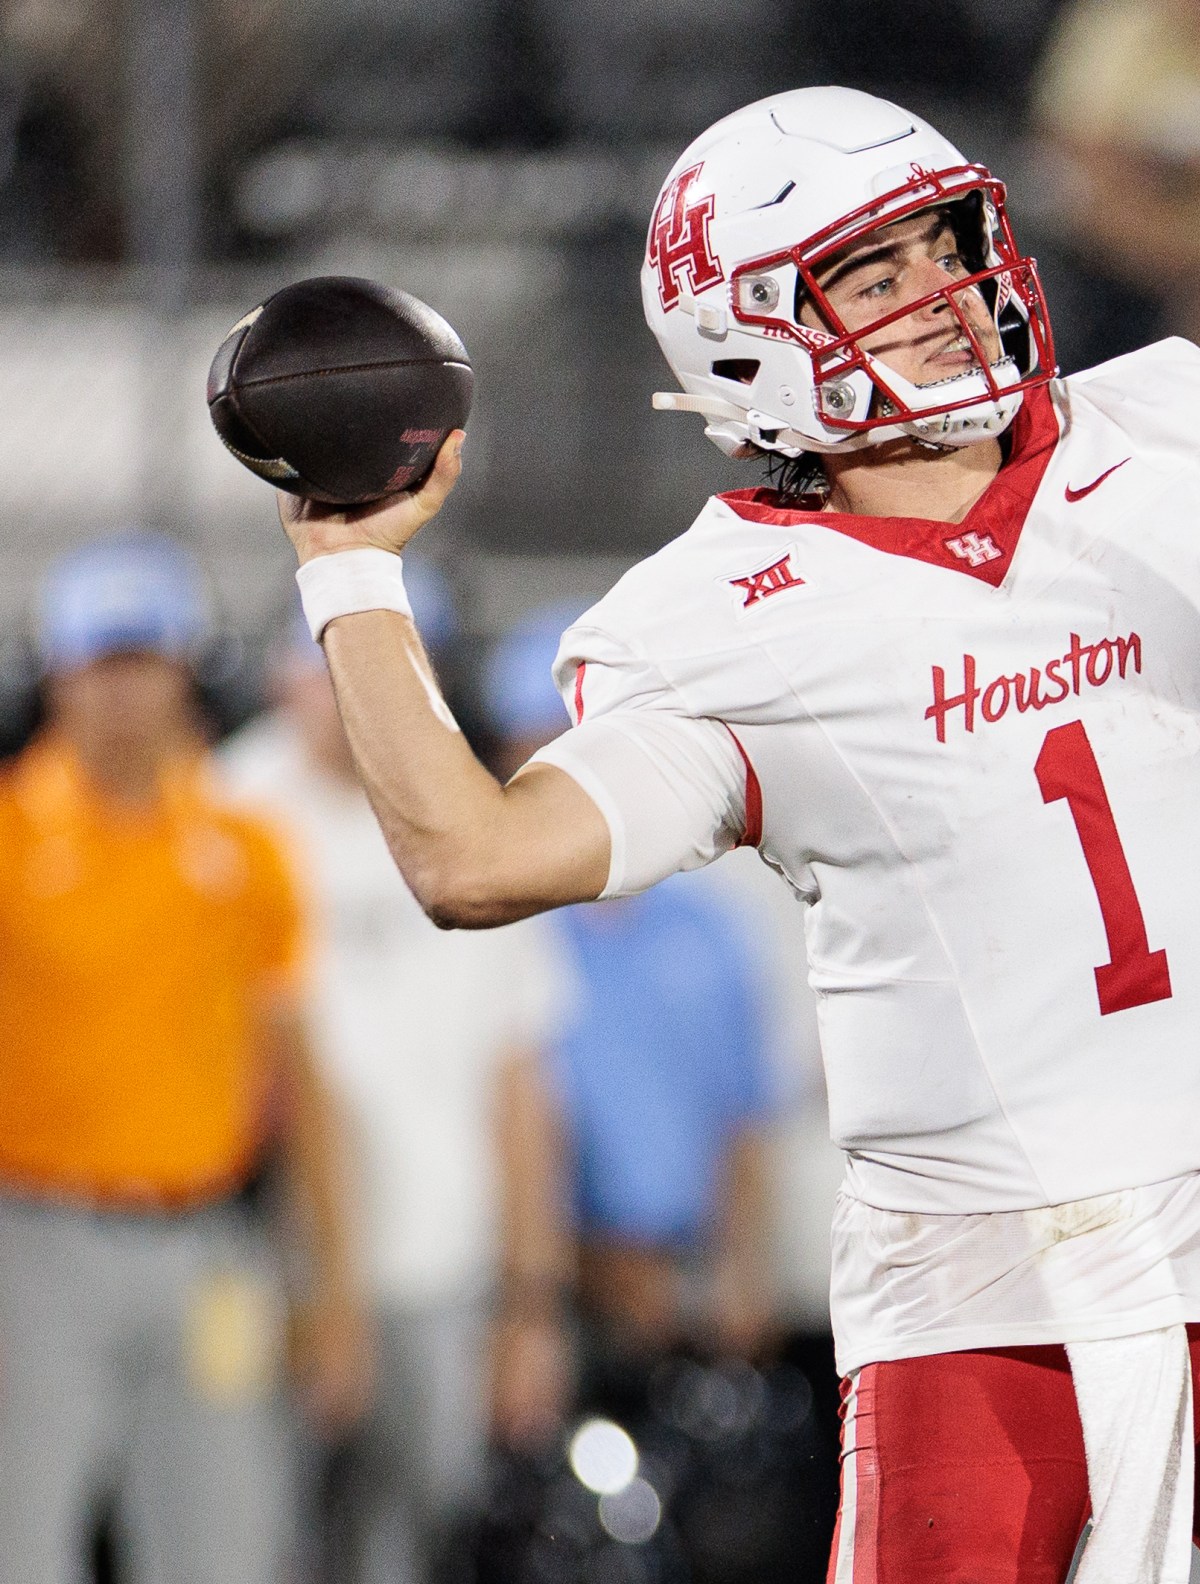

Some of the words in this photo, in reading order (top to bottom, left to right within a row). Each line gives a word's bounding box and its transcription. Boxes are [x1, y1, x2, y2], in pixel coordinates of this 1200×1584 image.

[648, 161, 725, 314] UH
[729, 553, 806, 609] XII
[943, 529, 1004, 568] UH
[924, 632, 1142, 743] Houston
[1034, 719, 1173, 1016] 1
